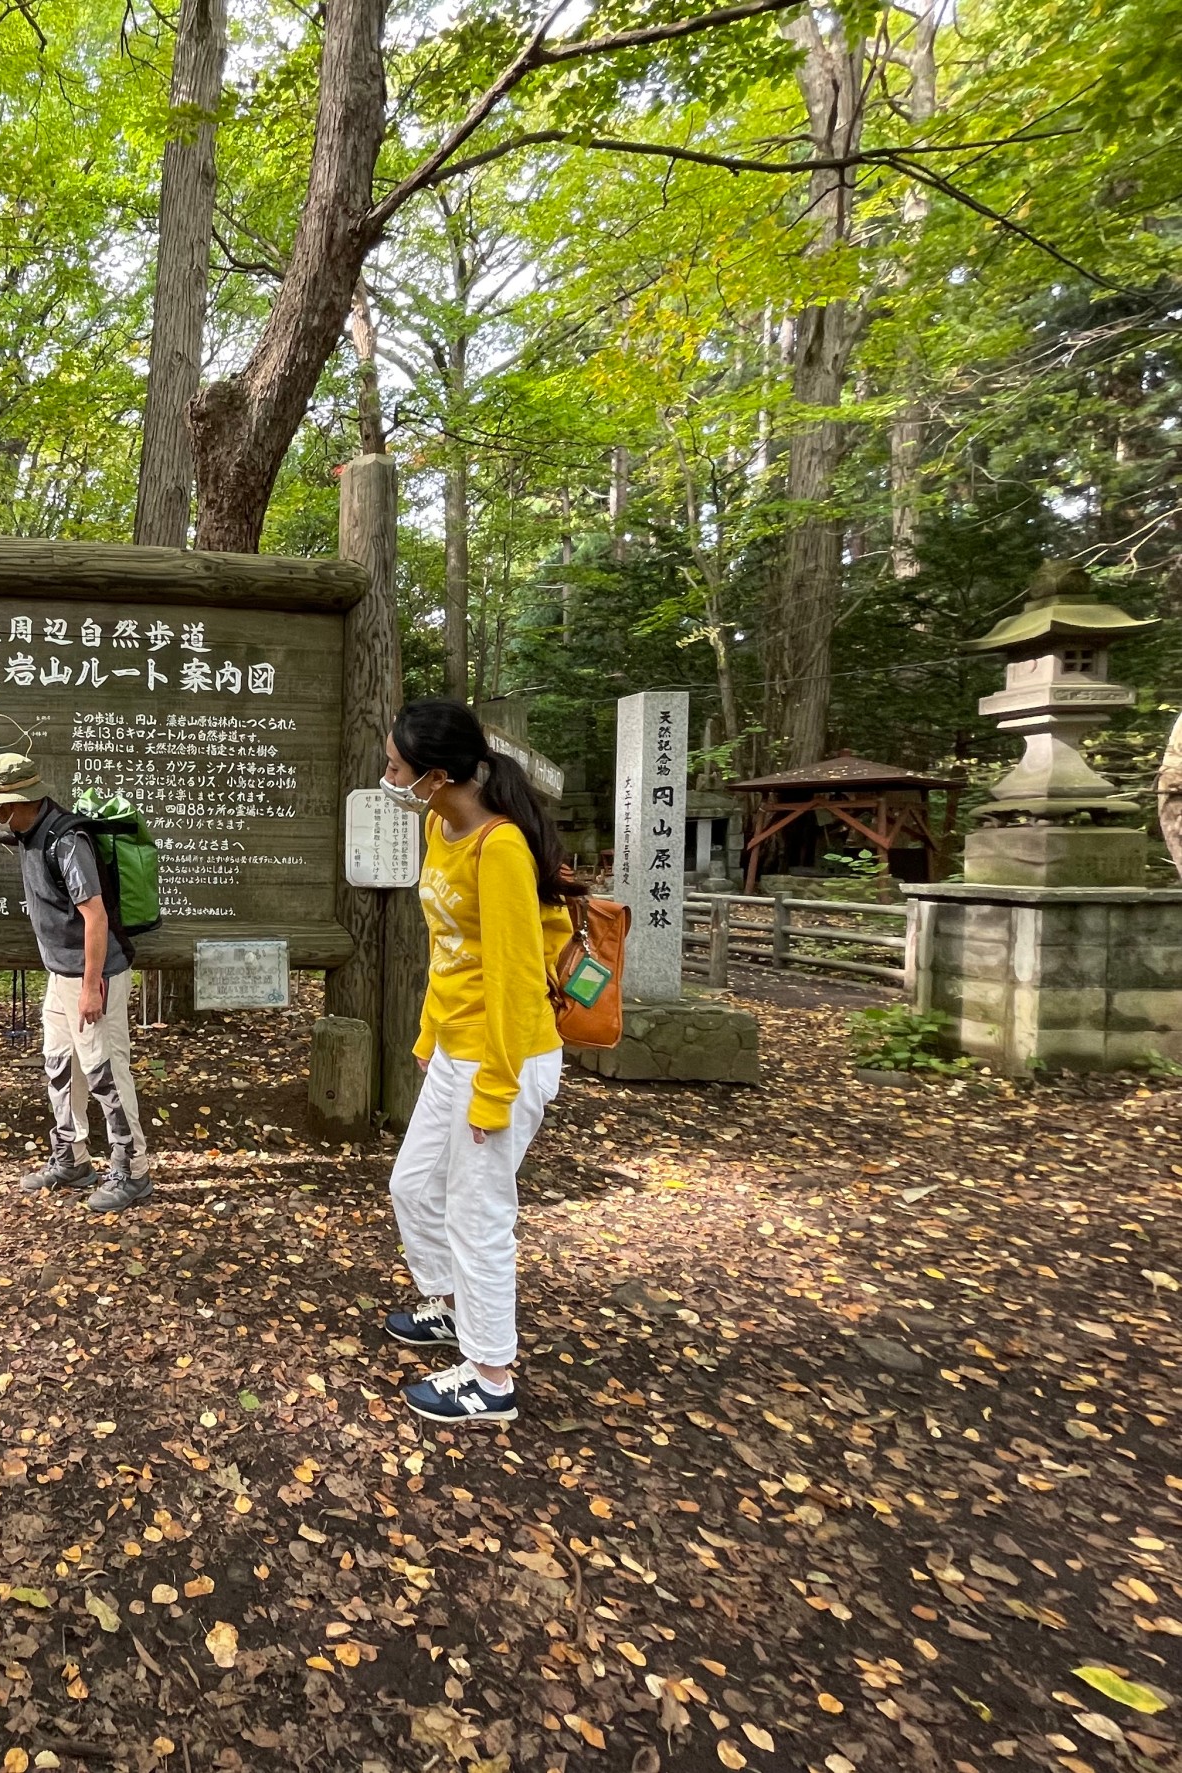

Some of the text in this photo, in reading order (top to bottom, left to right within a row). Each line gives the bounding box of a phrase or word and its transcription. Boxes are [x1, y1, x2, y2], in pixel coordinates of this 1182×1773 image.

[71, 786, 271, 803] 物登山者の目と耳を楽しませてくれます。
[647, 710, 675, 930] 天然記念物 円山原始林
[458, 1392, 488, 1415] N
